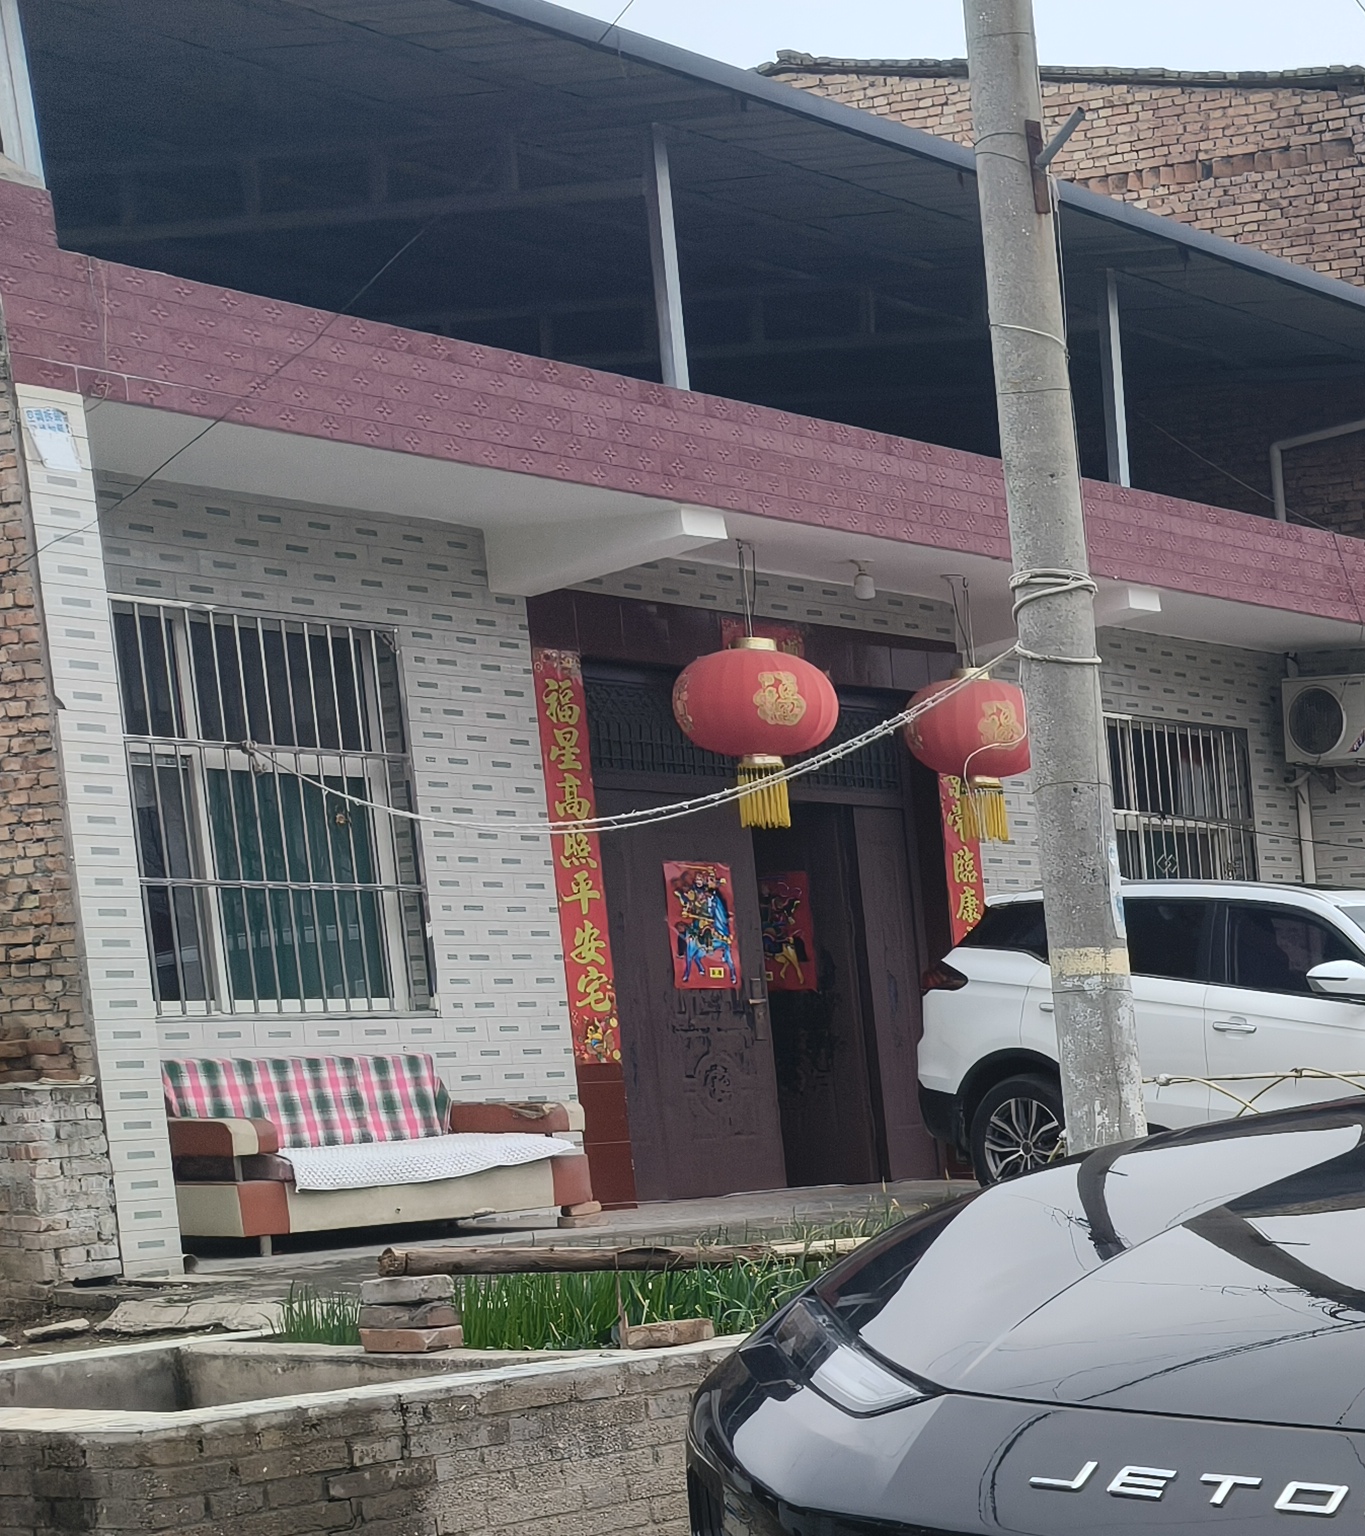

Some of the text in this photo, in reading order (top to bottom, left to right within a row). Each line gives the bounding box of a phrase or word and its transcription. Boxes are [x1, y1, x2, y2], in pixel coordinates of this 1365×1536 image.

[542, 678, 613, 1013] 福星高照平安宅
